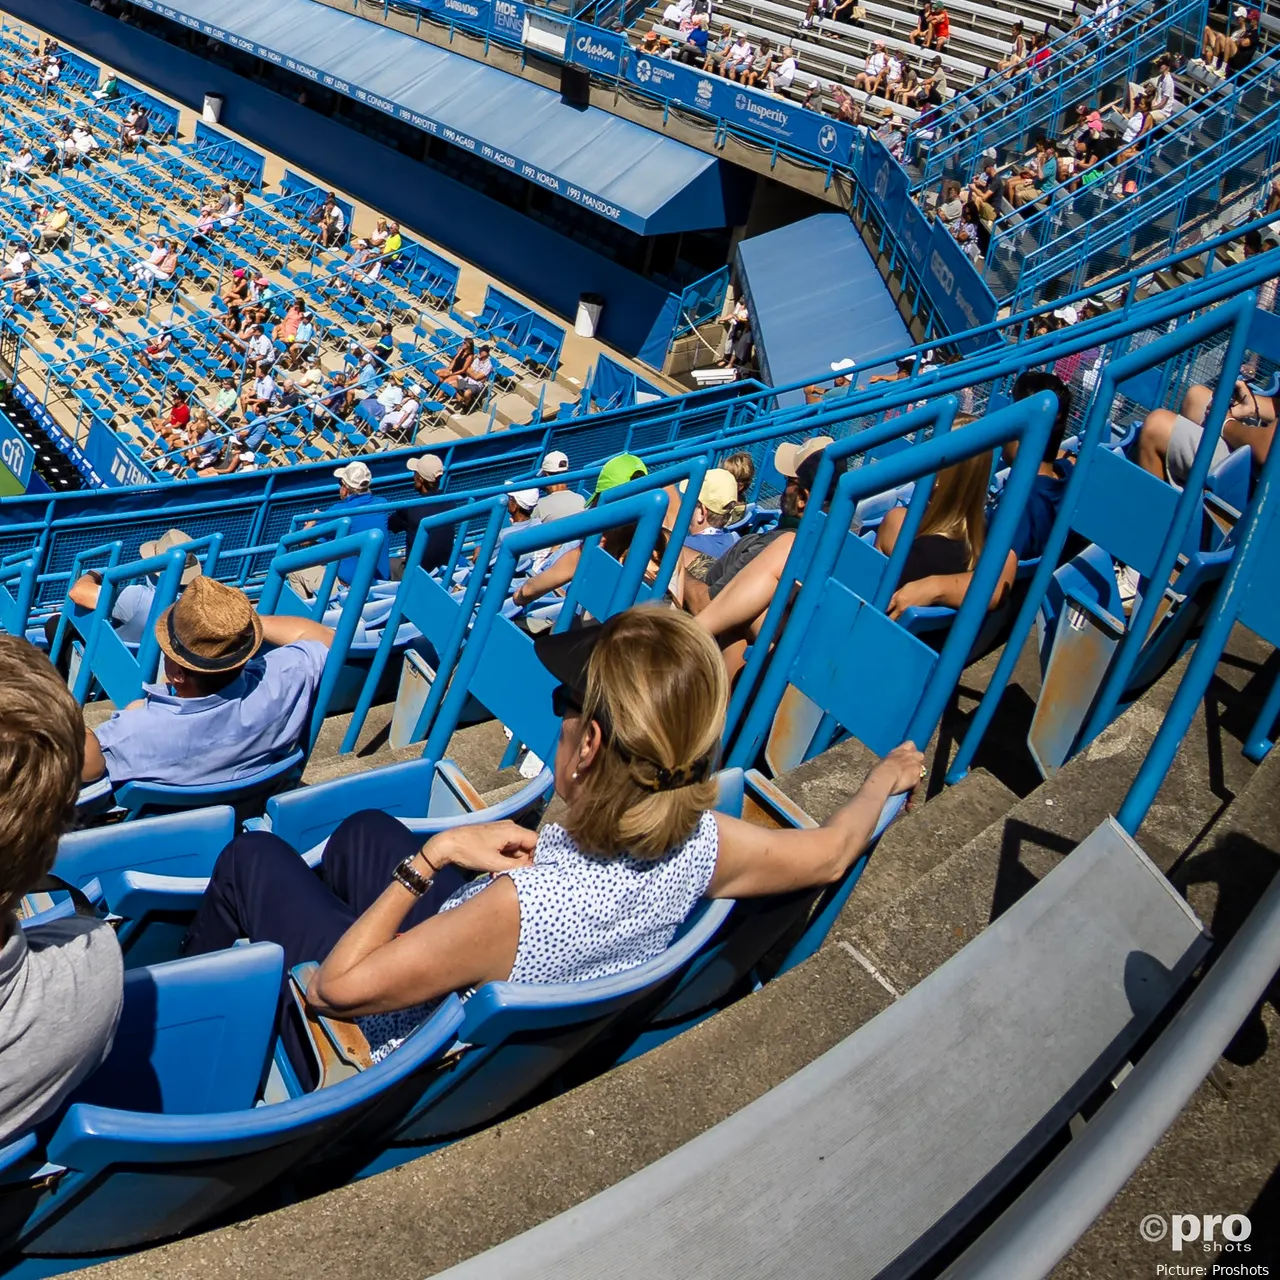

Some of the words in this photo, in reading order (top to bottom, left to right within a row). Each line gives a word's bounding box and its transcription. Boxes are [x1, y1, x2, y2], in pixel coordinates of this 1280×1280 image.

[496, 0, 519, 17] MDE.
[493, 11, 523, 32] TENNIS
[267, 51, 282, 63] NOAH
[576, 36, 616, 61] Chosen
[296, 64, 318, 80] NOVACEK
[652, 66, 675, 80] CUSTOM
[334, 80, 350, 94] LENDL
[367, 94, 394, 113] CONNORS
[411, 114, 437, 133] MAYOTTE
[747, 101, 788, 128] Insperity
[455, 134, 475, 149] AGASSI
[493, 152, 515, 168] AGASSI
[536, 172, 559, 190] KORDA
[582, 194, 621, 219] MANSDORF
[2, 439, 24, 476] citi
